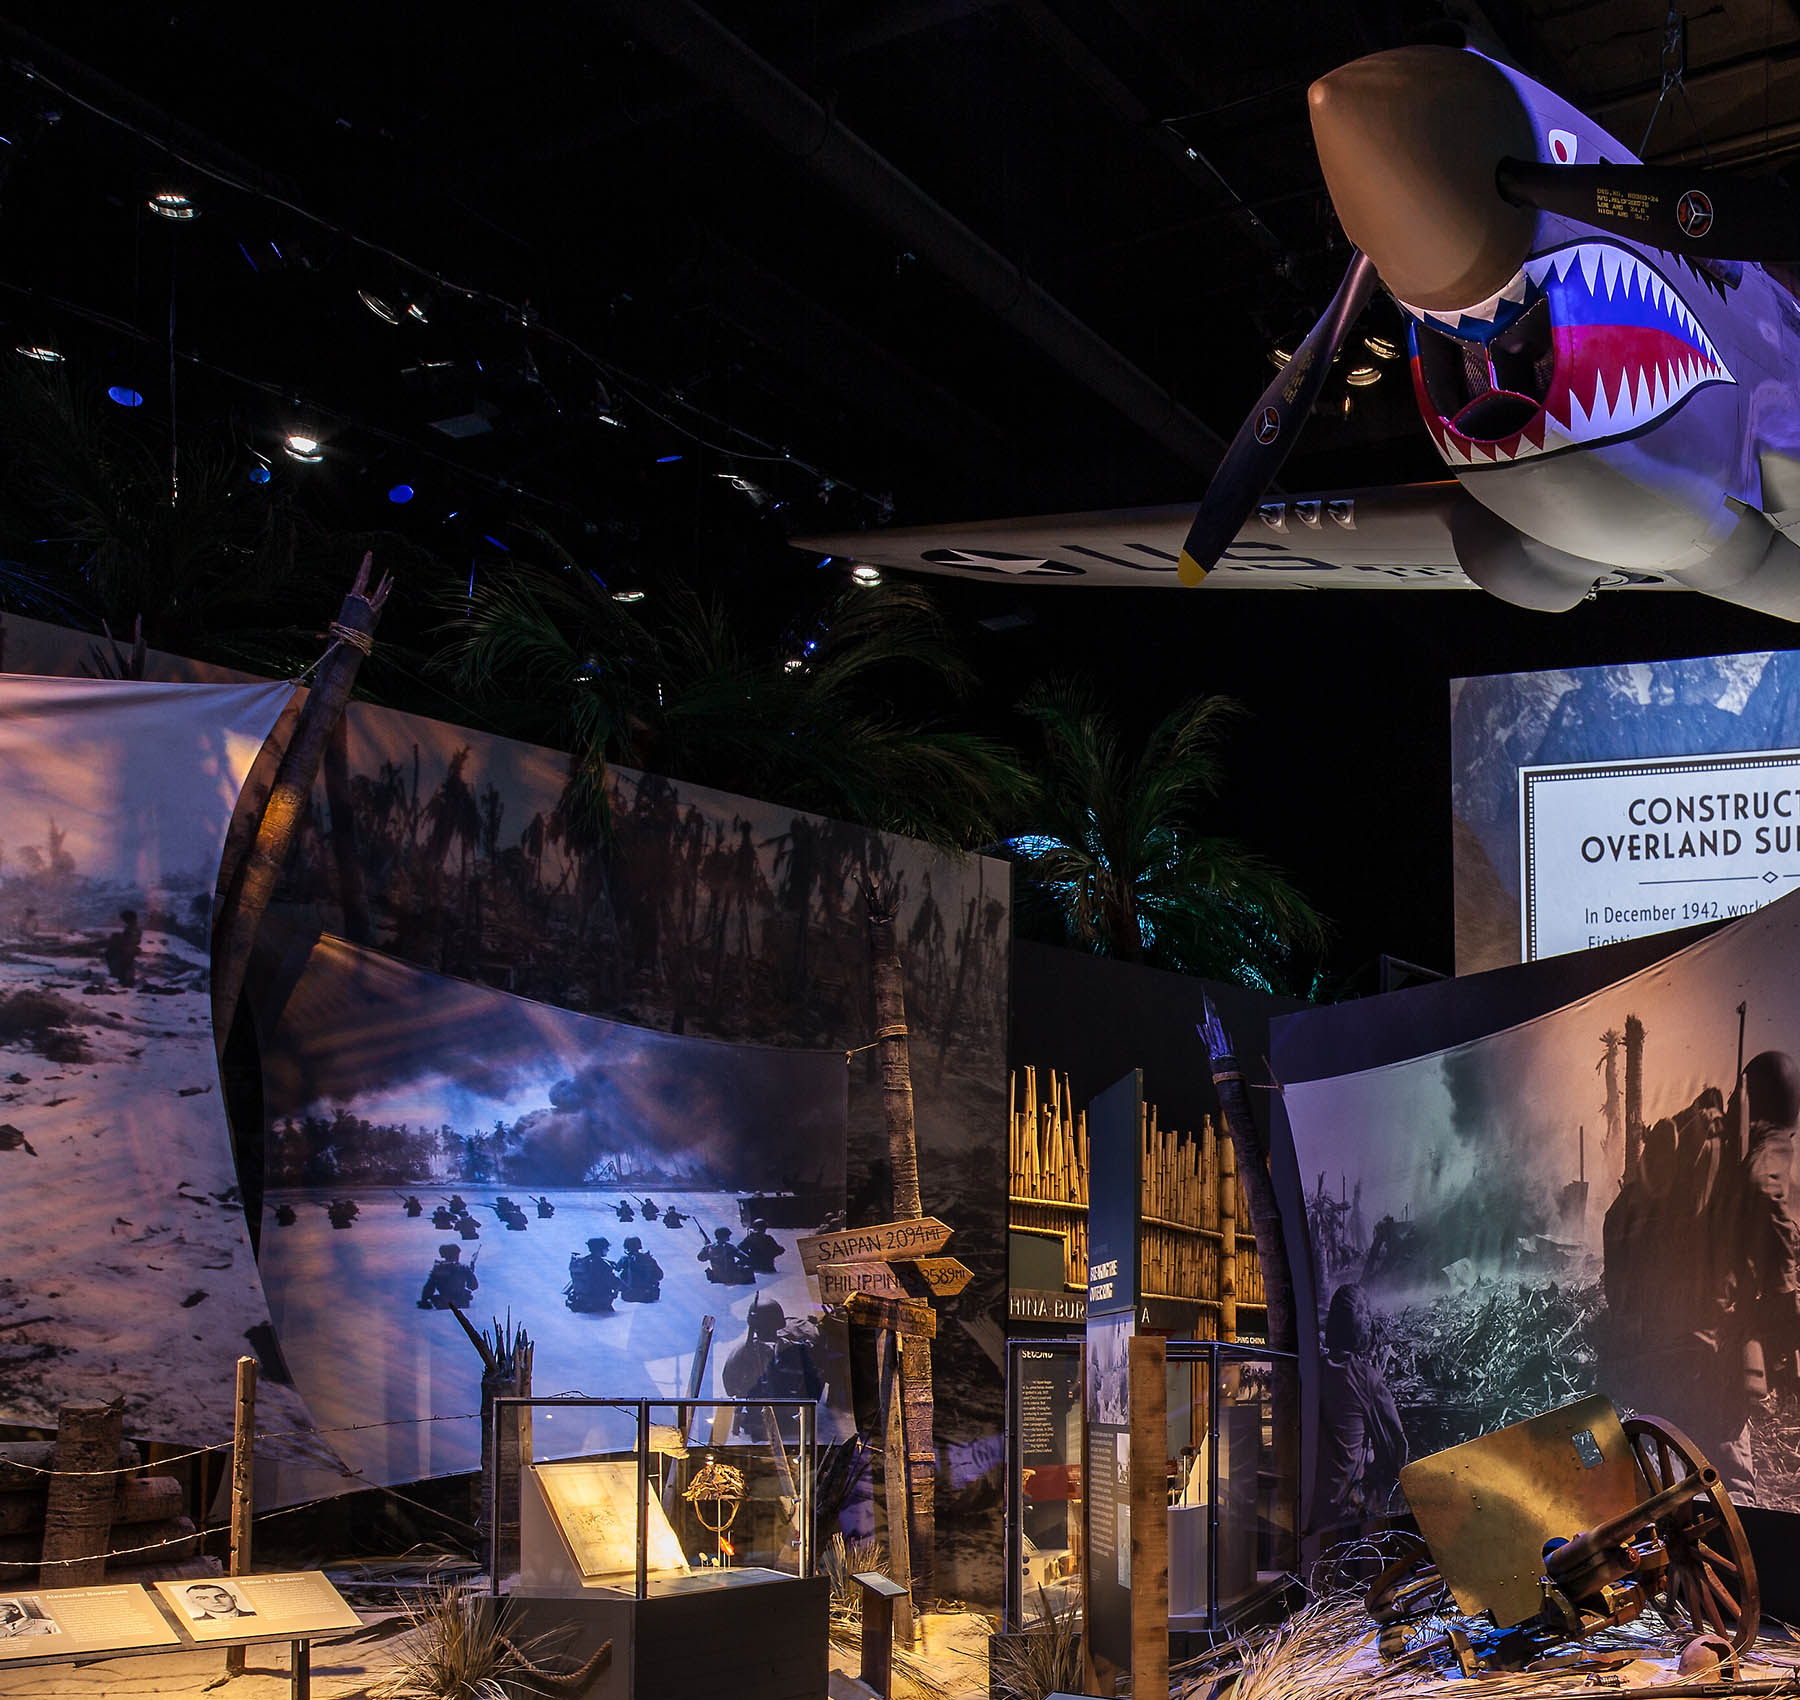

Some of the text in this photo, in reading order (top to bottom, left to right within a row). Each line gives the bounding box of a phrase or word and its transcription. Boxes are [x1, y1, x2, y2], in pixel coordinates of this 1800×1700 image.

[1581, 829, 1742, 863] OVERLAND
[1585, 908, 1598, 924] In
[1604, 905, 1676, 923] December
[1682, 901, 1724, 920] 1942,
[819, 1236, 881, 1261] SAIPAN
